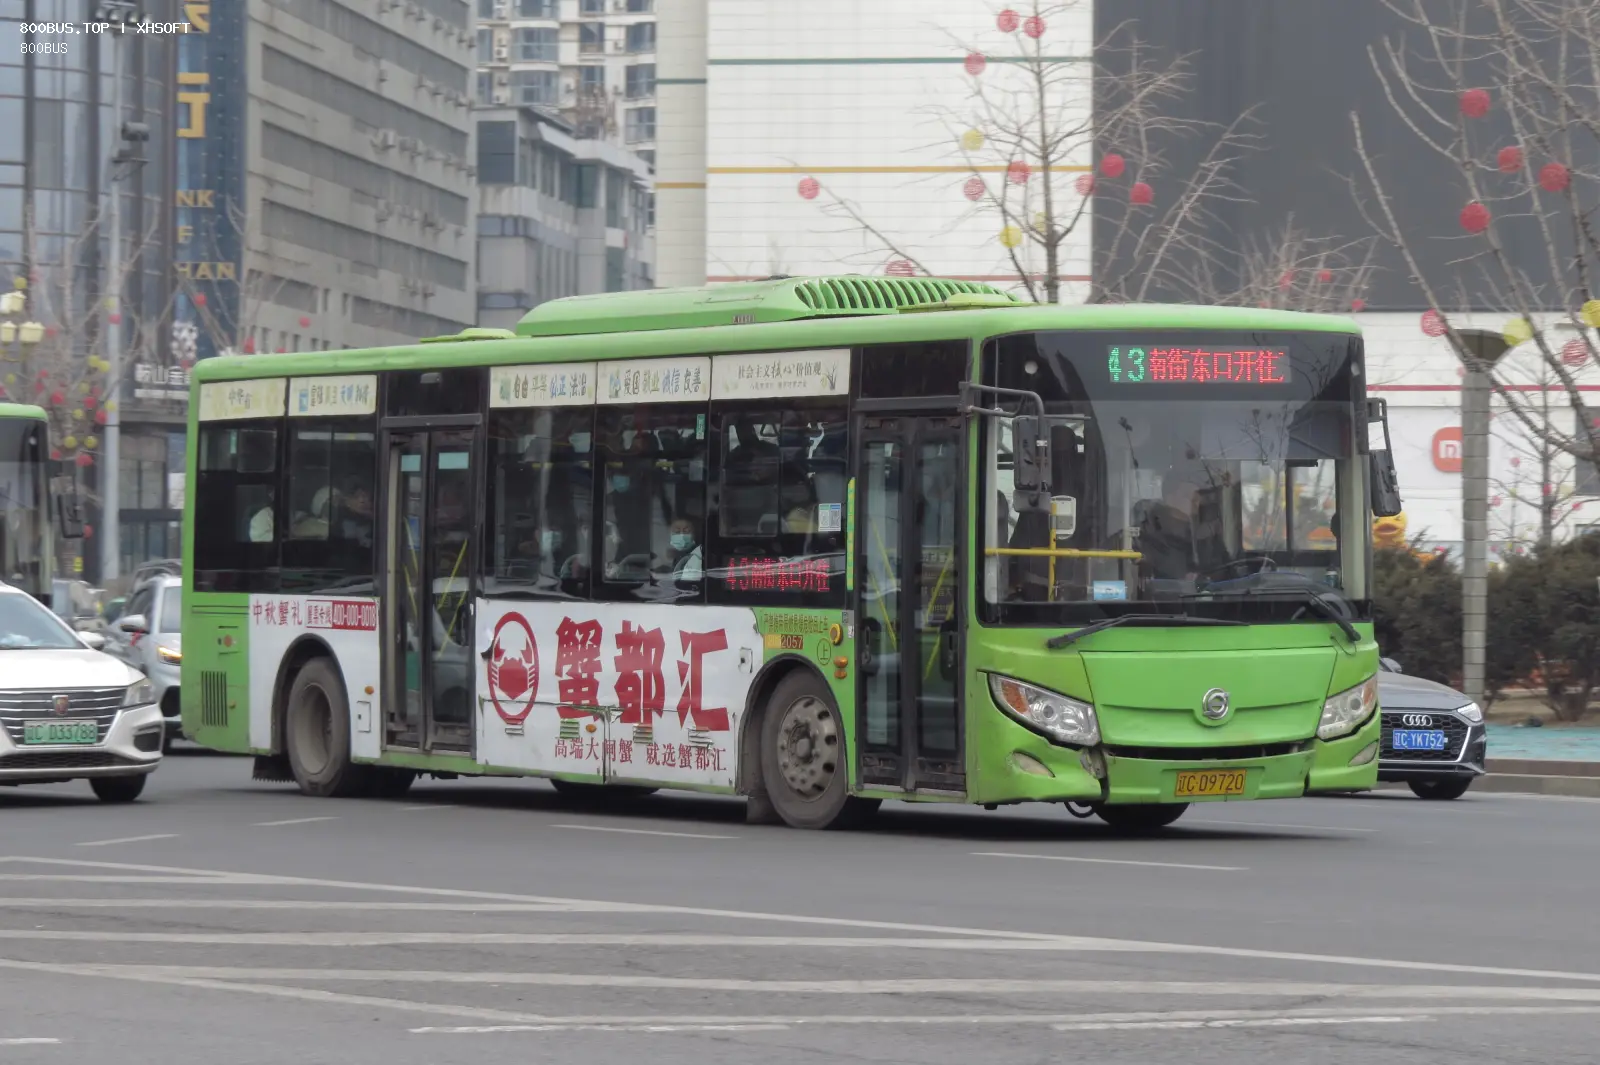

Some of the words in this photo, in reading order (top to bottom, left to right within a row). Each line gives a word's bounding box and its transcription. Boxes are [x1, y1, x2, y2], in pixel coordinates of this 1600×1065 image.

[738, 360, 822, 380] 社会主义核心价值观
[1108, 347, 1146, 382] 43
[513, 371, 588, 401] 自由平等公正法治
[623, 366, 702, 397] 爱国敬业诚信友善
[252, 599, 303, 627] 中秋蟹礼
[780, 635, 803, 650] 2057
[554, 615, 731, 732] 蟹都汇
[554, 737, 633, 766] 高端大闸蟹
[646, 742, 728, 772] 就选蟹都汇
